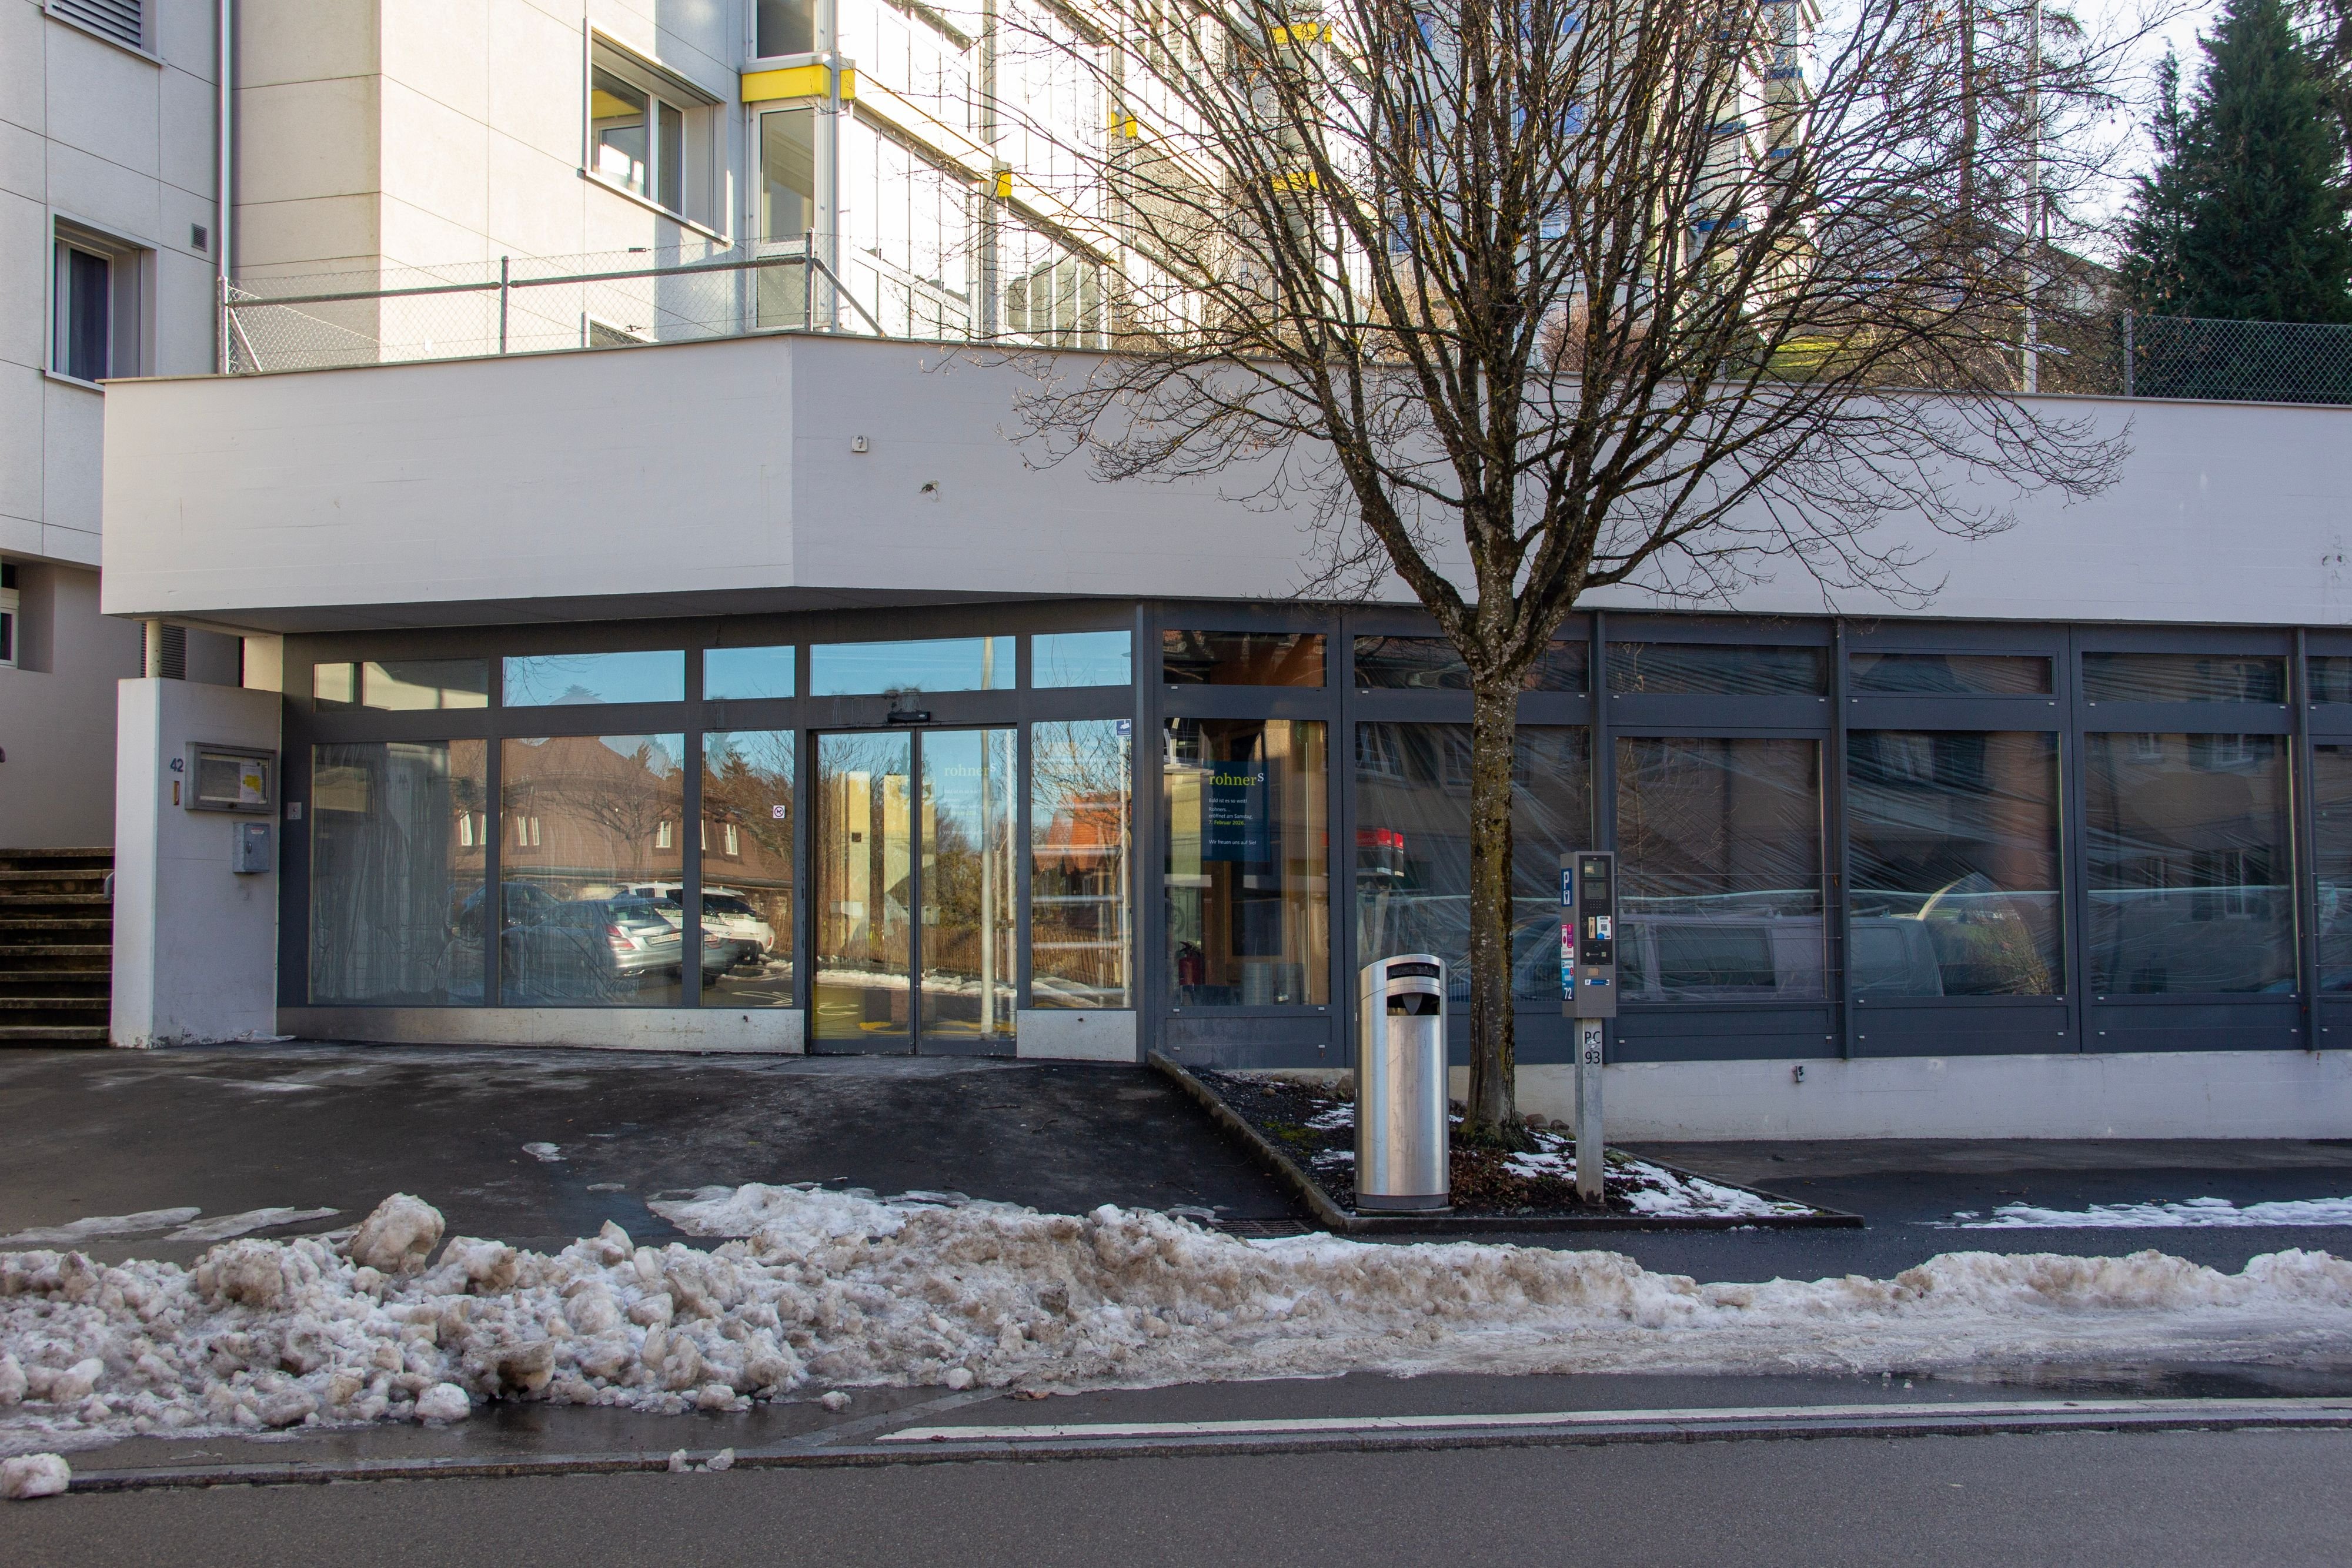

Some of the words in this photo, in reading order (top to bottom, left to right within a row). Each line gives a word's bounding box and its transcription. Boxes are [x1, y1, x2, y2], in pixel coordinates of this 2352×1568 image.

[170, 757, 184, 773] 42
[1563, 871, 1569, 890] P
[1564, 987, 1572, 999] 72
[1585, 1031, 1601, 1044] PC
[1585, 1051, 1601, 1064] 93
